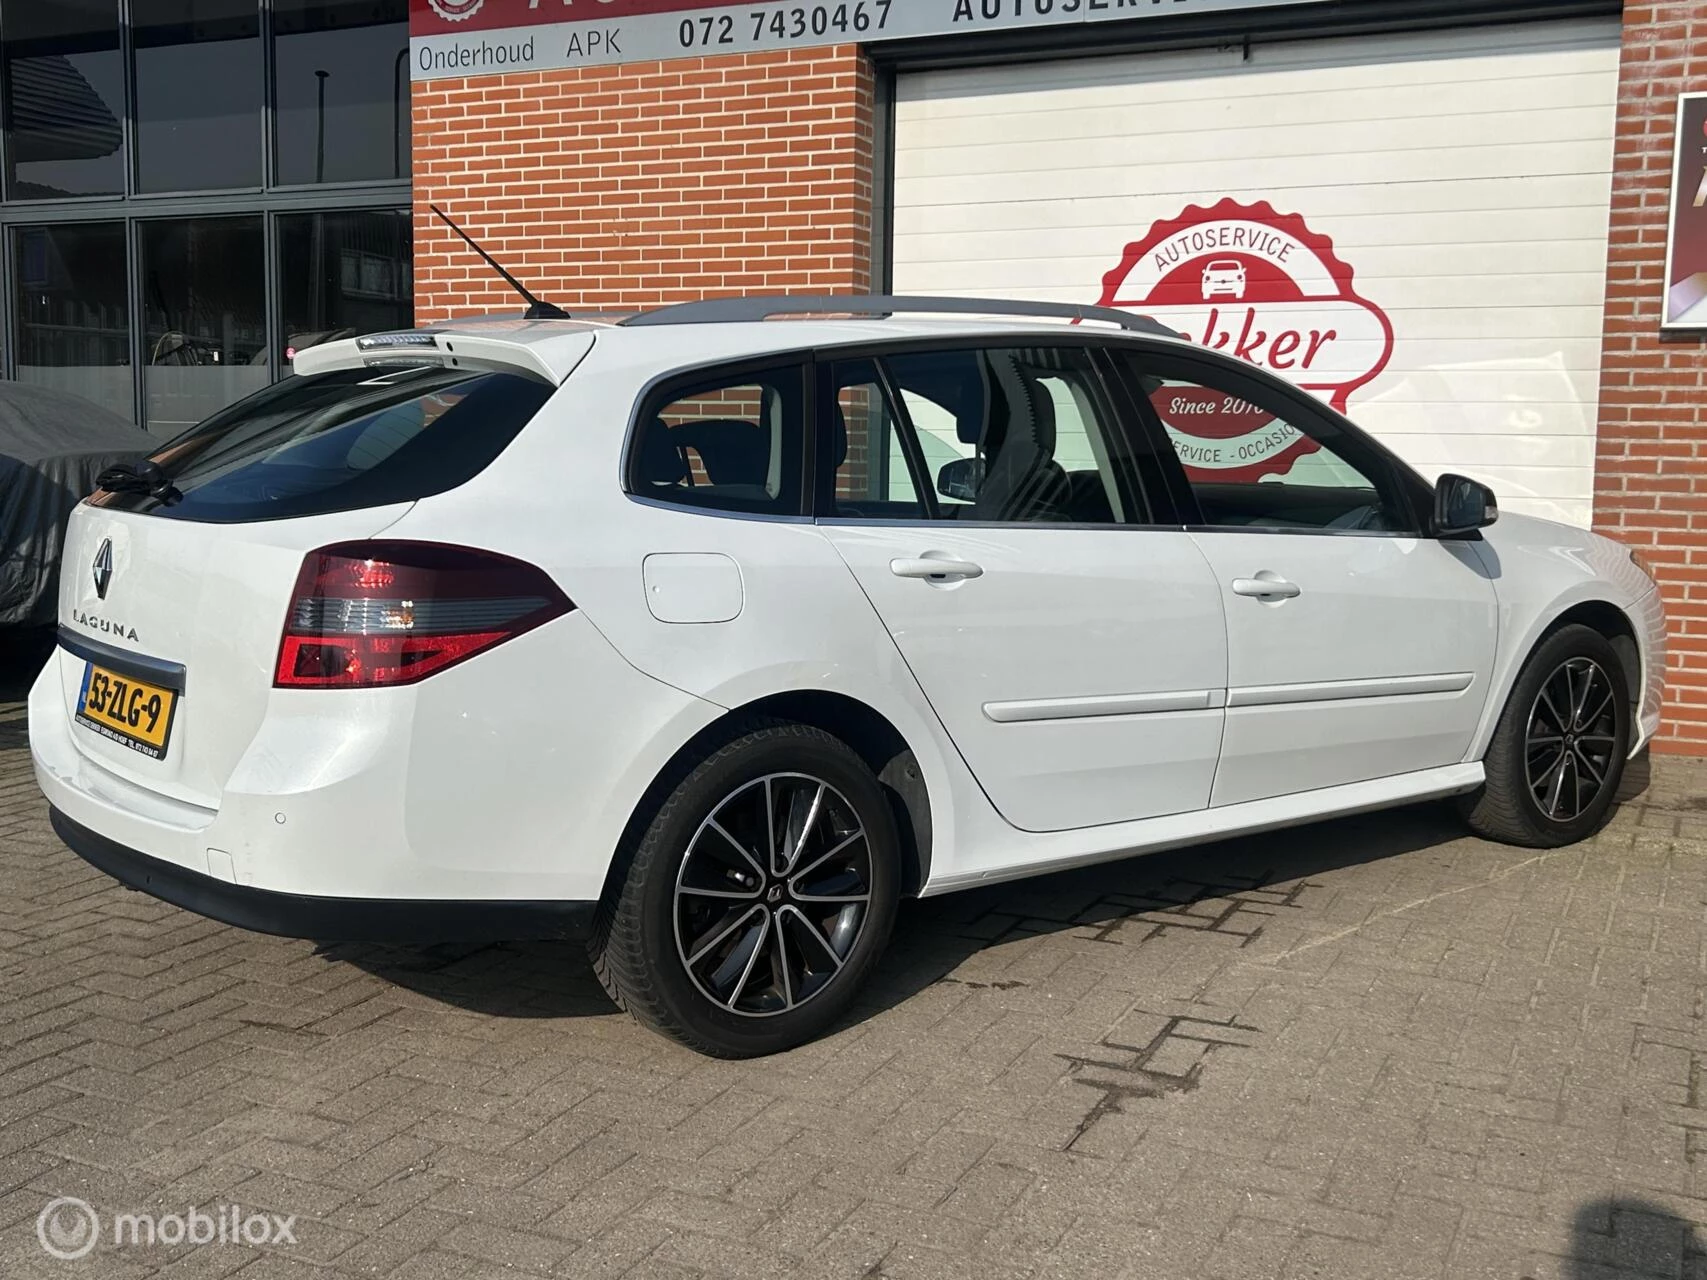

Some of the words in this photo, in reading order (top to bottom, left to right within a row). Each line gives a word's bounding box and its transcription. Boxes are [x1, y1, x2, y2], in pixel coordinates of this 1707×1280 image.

[419, 35, 535, 71] Onderhoud
[566, 28, 622, 58] APK
[679, 15, 734, 48] 072
[751, 0, 892, 41] 7430467
[1153, 227, 1295, 273] AUTOSERVICE
[1177, 307, 1337, 370] kker
[1169, 396, 1216, 415] Since
[1173, 440, 1221, 462] ERVICE
[73, 609, 139, 642] LAGUNA
[88, 672, 162, 734] 53-ZLG-9
